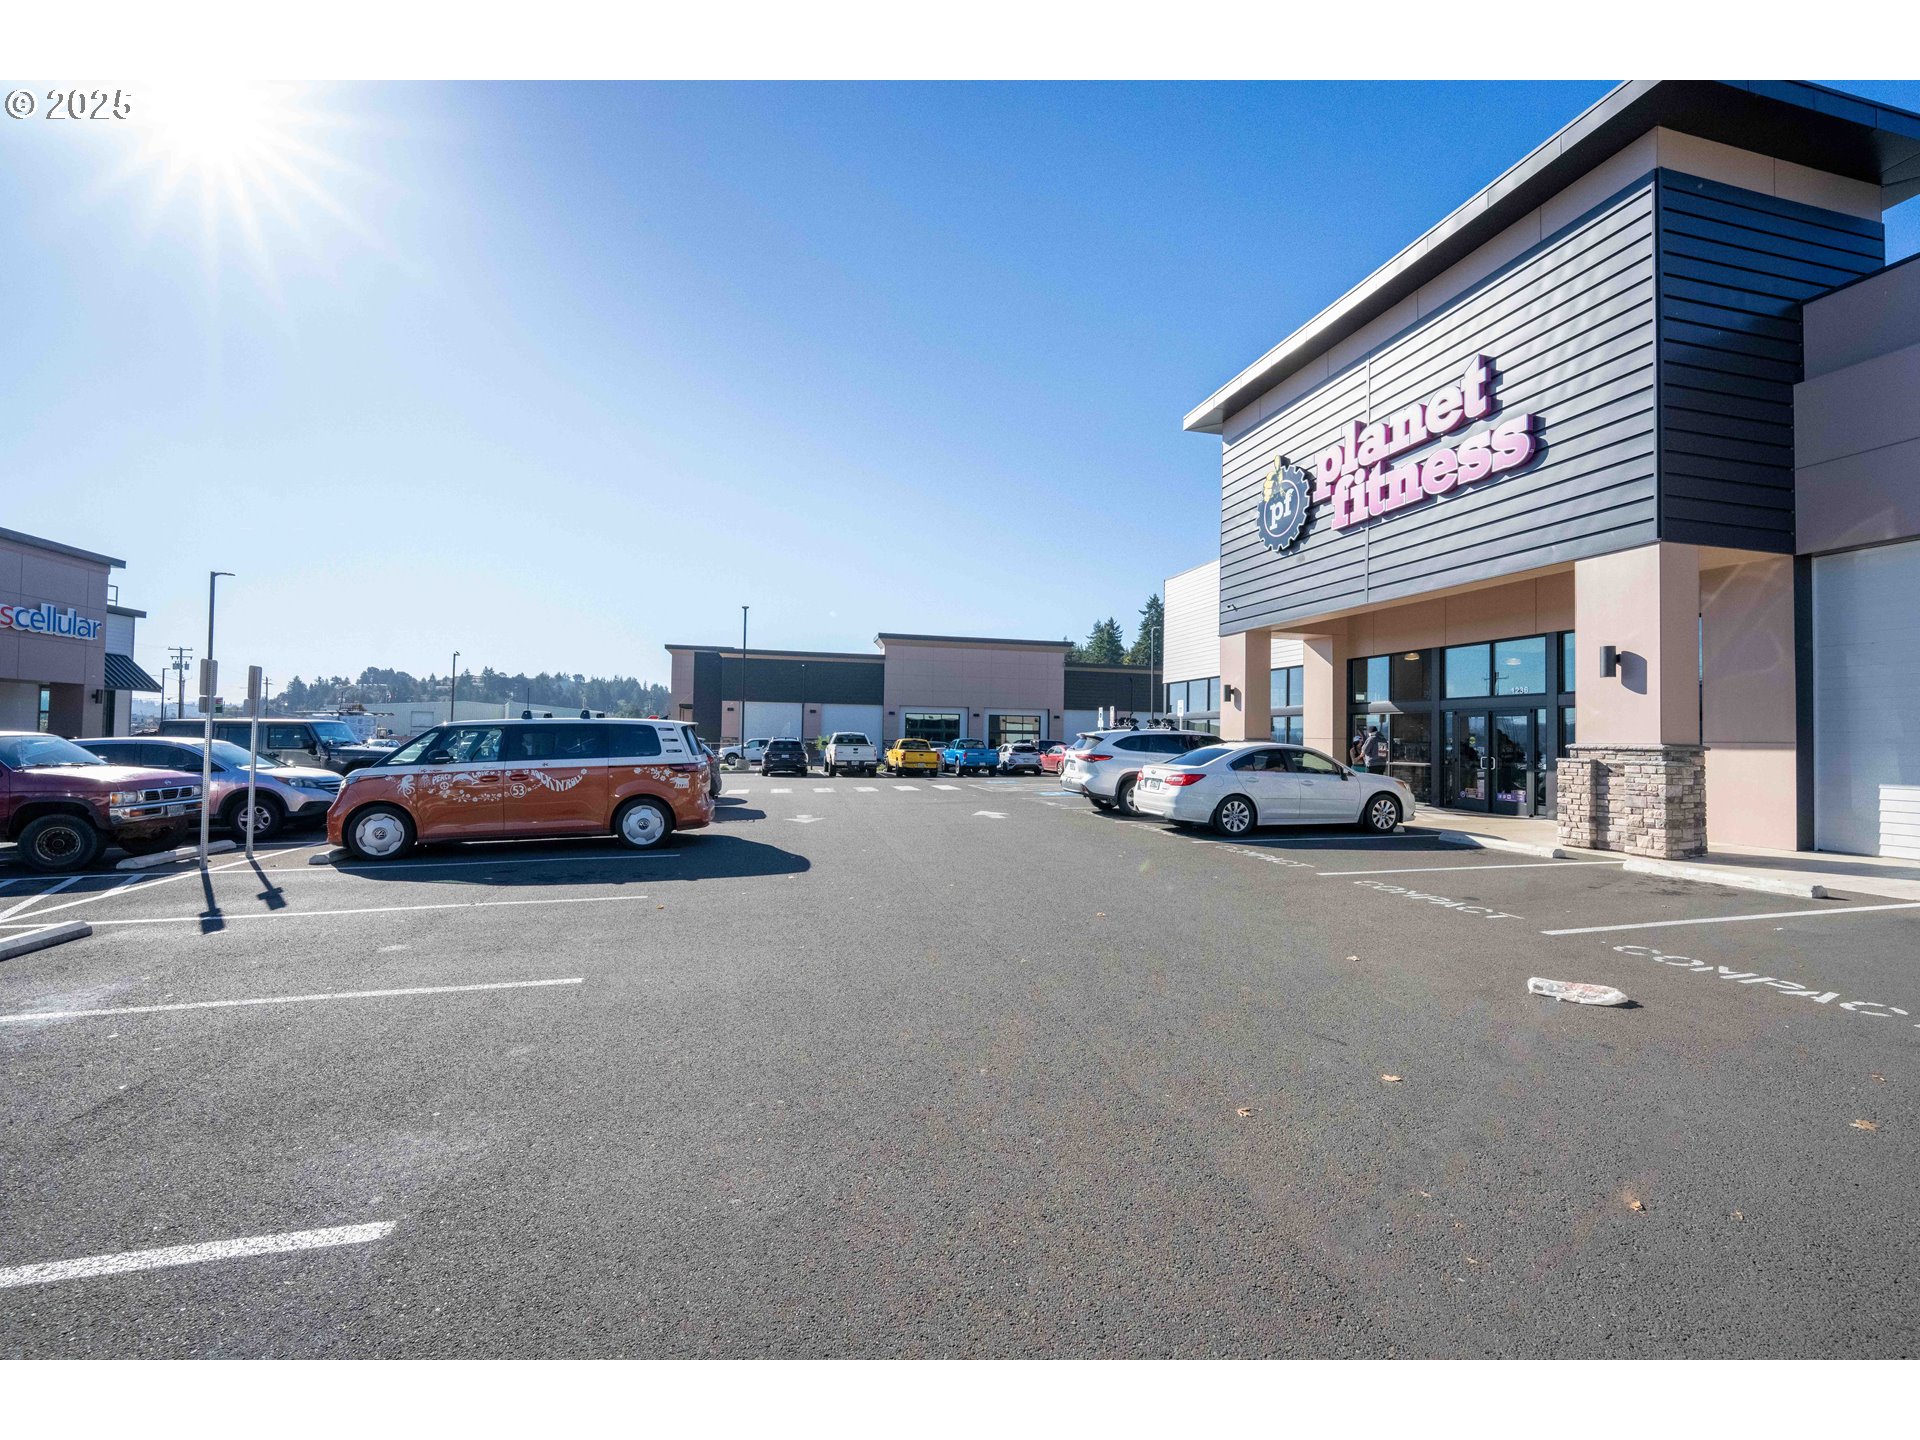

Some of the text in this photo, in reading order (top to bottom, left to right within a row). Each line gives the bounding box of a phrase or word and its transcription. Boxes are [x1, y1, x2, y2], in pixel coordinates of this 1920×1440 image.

[1313, 354, 1491, 503] planet
[1332, 413, 1536, 530] fitness
[1269, 488, 1295, 531] pf
[512, 785, 525, 796] 53
[1353, 880, 1525, 919] COMPACT
[1613, 945, 1920, 1028] COMPAC
